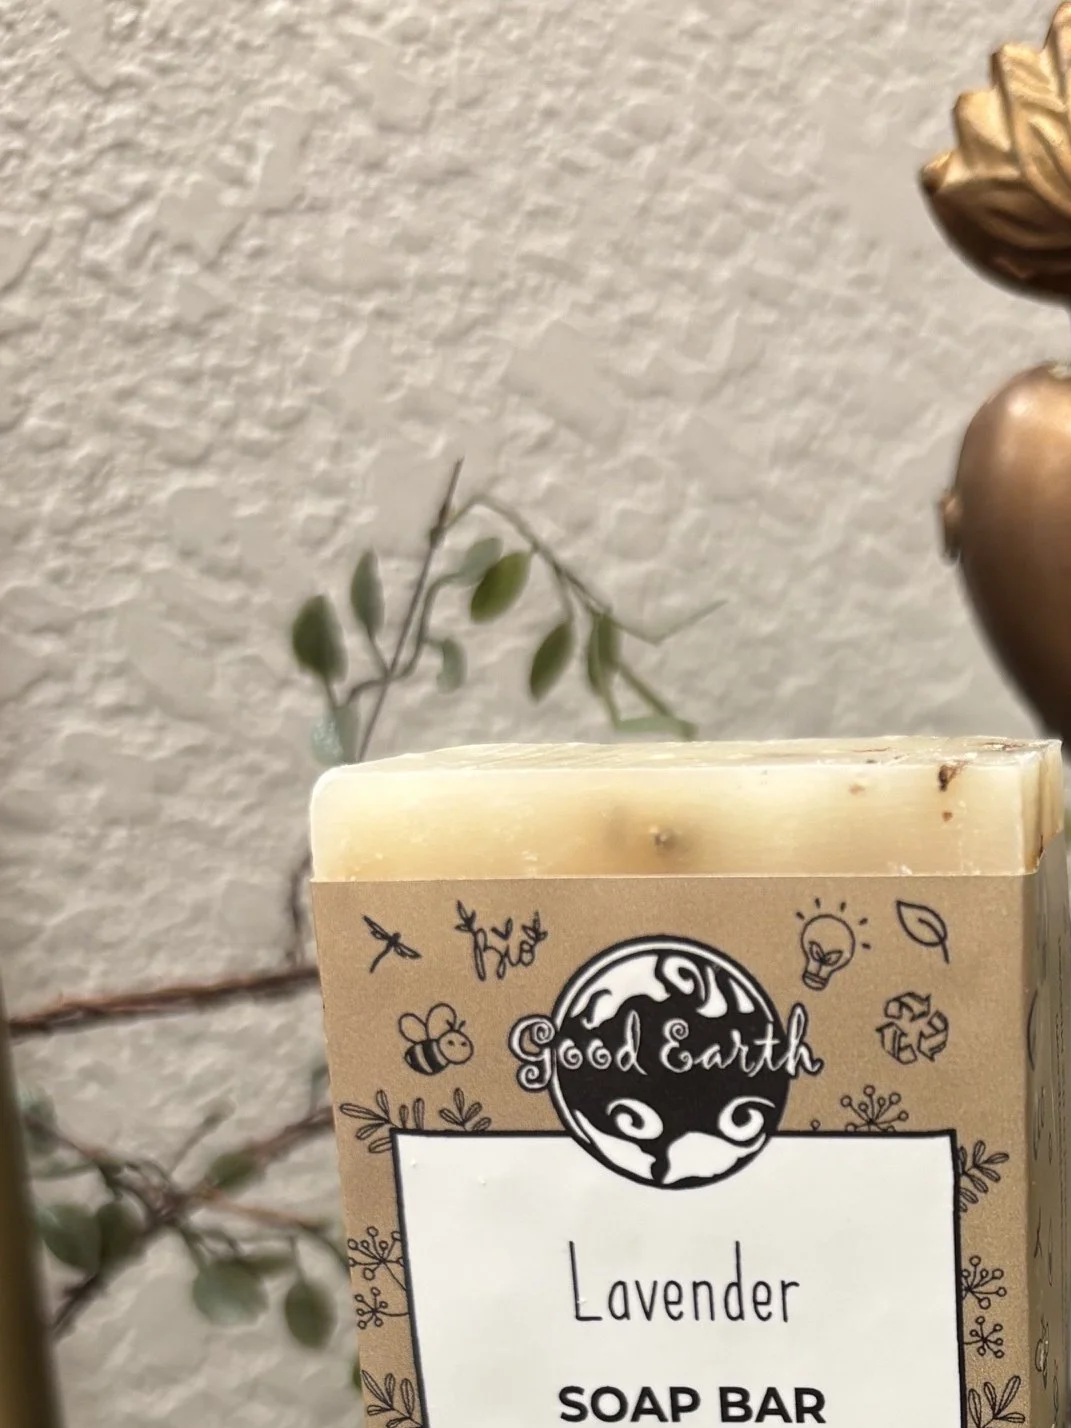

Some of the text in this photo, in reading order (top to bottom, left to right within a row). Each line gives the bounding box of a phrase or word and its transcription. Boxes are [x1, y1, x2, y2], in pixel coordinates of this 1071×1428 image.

[508, 1003, 824, 1093] Good Earth
[567, 1239, 802, 1325] Lavender
[556, 1384, 828, 1425] SOAP BAR
